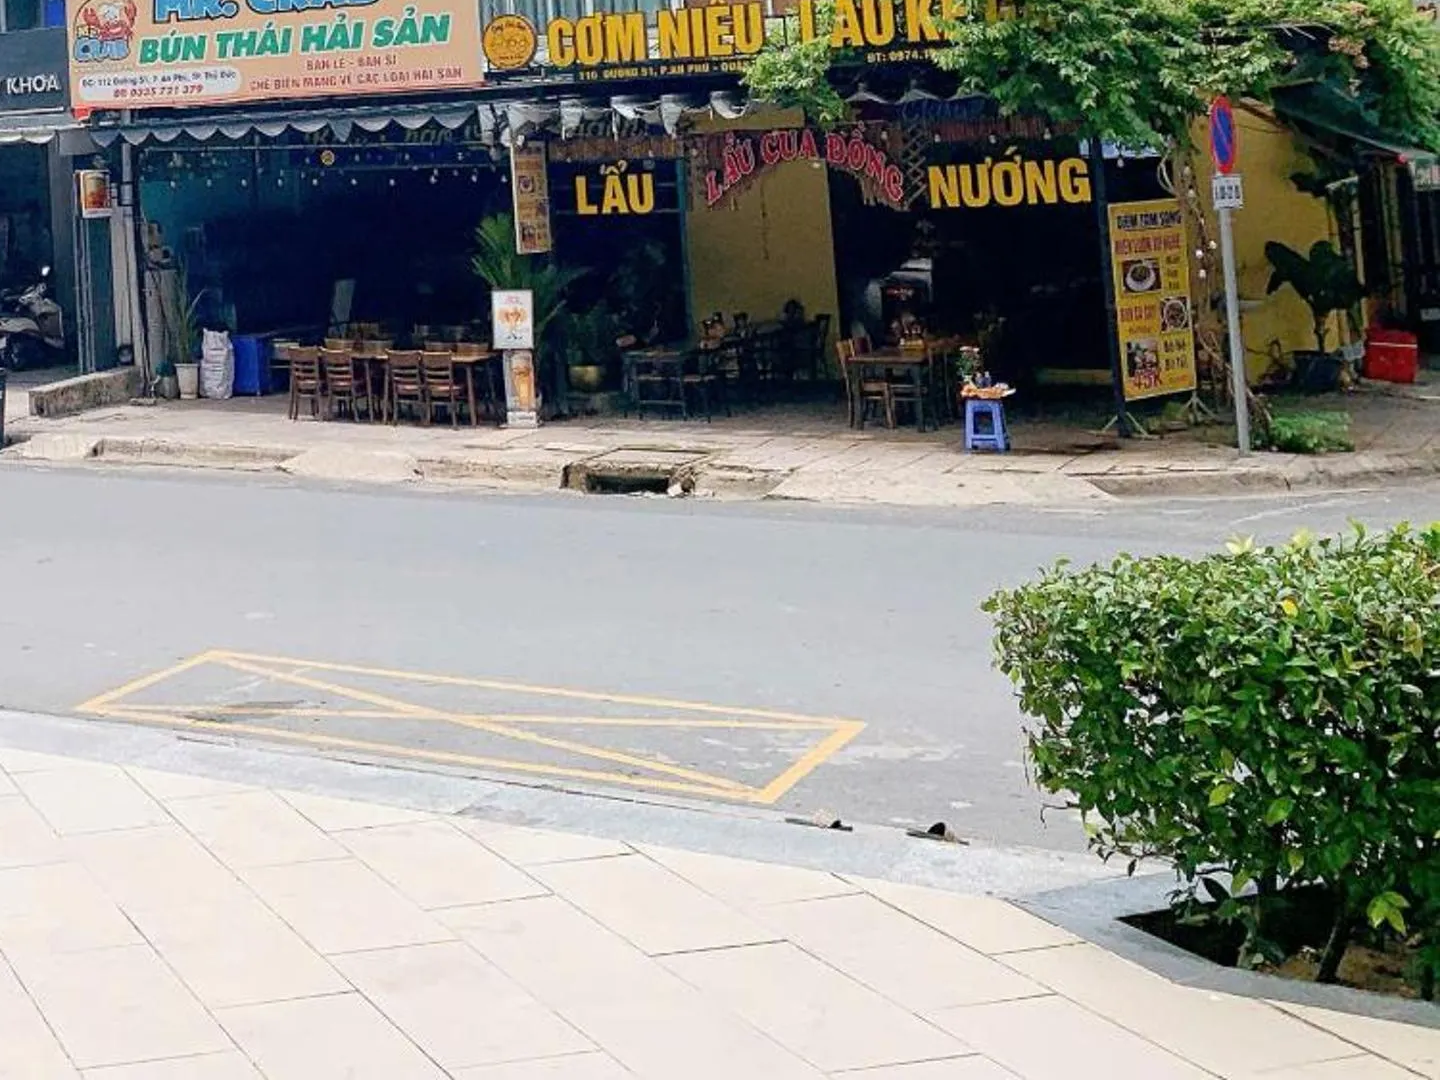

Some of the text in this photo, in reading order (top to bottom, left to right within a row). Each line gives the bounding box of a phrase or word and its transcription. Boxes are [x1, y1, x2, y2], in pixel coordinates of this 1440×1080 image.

[139, 5, 453, 65] BÚN THÁI HẢI SẢN
[548, 11, 646, 67] CƠM
[6, 72, 61, 96] KHOA
[760, 128, 820, 166] CUA
[574, 159, 655, 215] LẨU
[928, 144, 1093, 210] NƯỚNG
